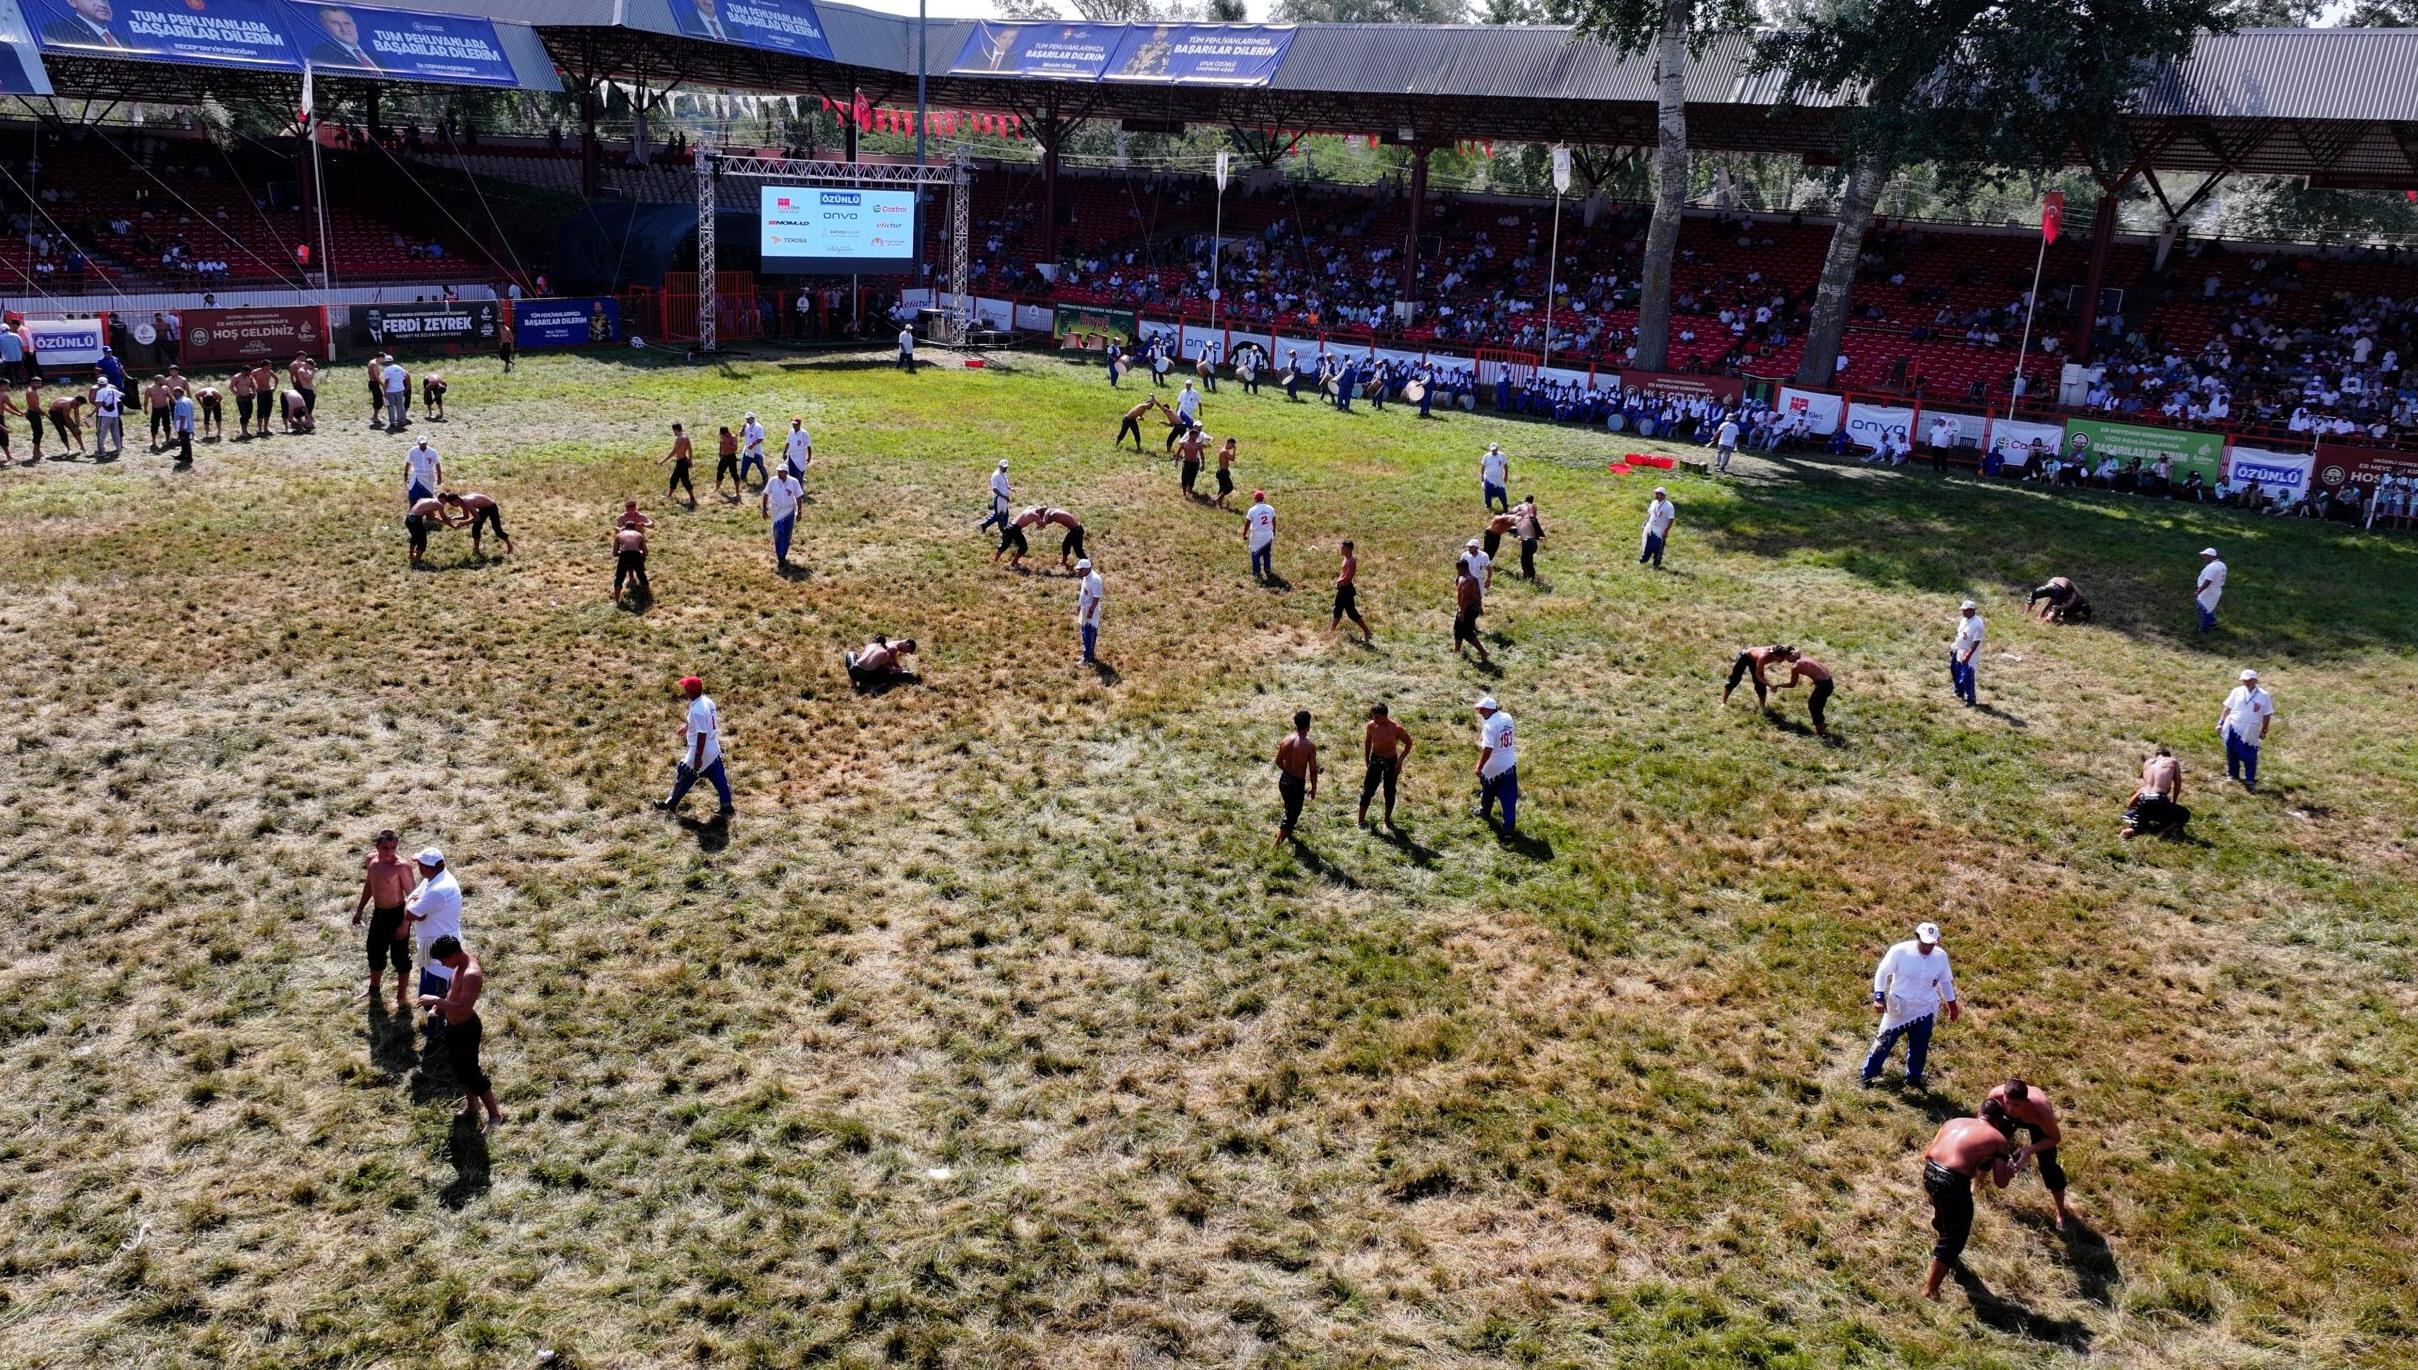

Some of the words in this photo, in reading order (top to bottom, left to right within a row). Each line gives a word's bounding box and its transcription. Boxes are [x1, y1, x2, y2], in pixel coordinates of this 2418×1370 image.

[727, 11, 782, 31] BAŞARILAR
[128, 20, 222, 41] BAŞARILAR
[372, 39, 449, 57] BAŞARILAR
[1025, 49, 1070, 60] BAŞARILAR
[1174, 44, 1232, 56] BAŞARILAR
[1233, 45, 1278, 56] DİLERİM
[822, 193, 860, 204] ÖZÜNLÜ
[823, 212, 858, 220] onvo
[882, 205, 907, 213] Castrol
[382, 318, 421, 333] FERDİ
[424, 317, 473, 331] ZEYREK
[213, 329, 239, 341] HOŞ
[241, 325, 295, 338] GELDİNİZ
[35, 335, 95, 349] ÖZÜNLÜ
[2237, 466, 2299, 484] ÖZÜNLÜ
[1260, 516, 1269, 526] 2
